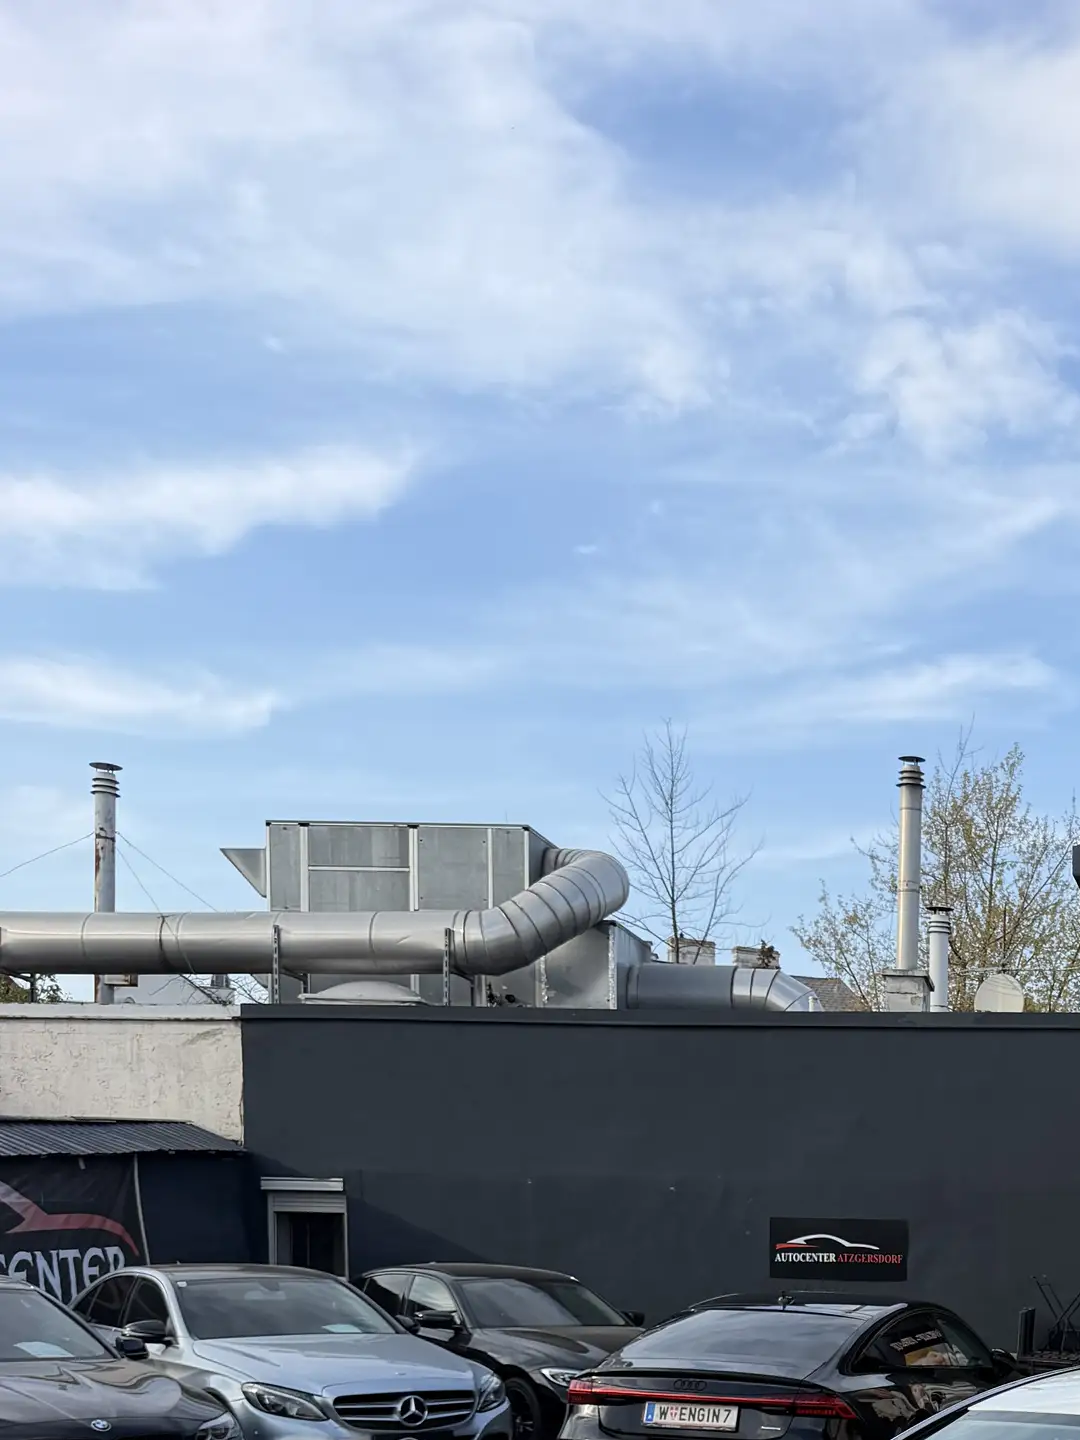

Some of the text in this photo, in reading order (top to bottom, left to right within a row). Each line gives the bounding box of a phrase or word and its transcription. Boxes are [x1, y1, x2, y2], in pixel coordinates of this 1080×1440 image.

[775, 1252, 903, 1264] AUTOCENTER ATZGERSDORF
[0, 1246, 125, 1302] ENTER
[659, 1406, 732, 1423] W ENGIN 7
